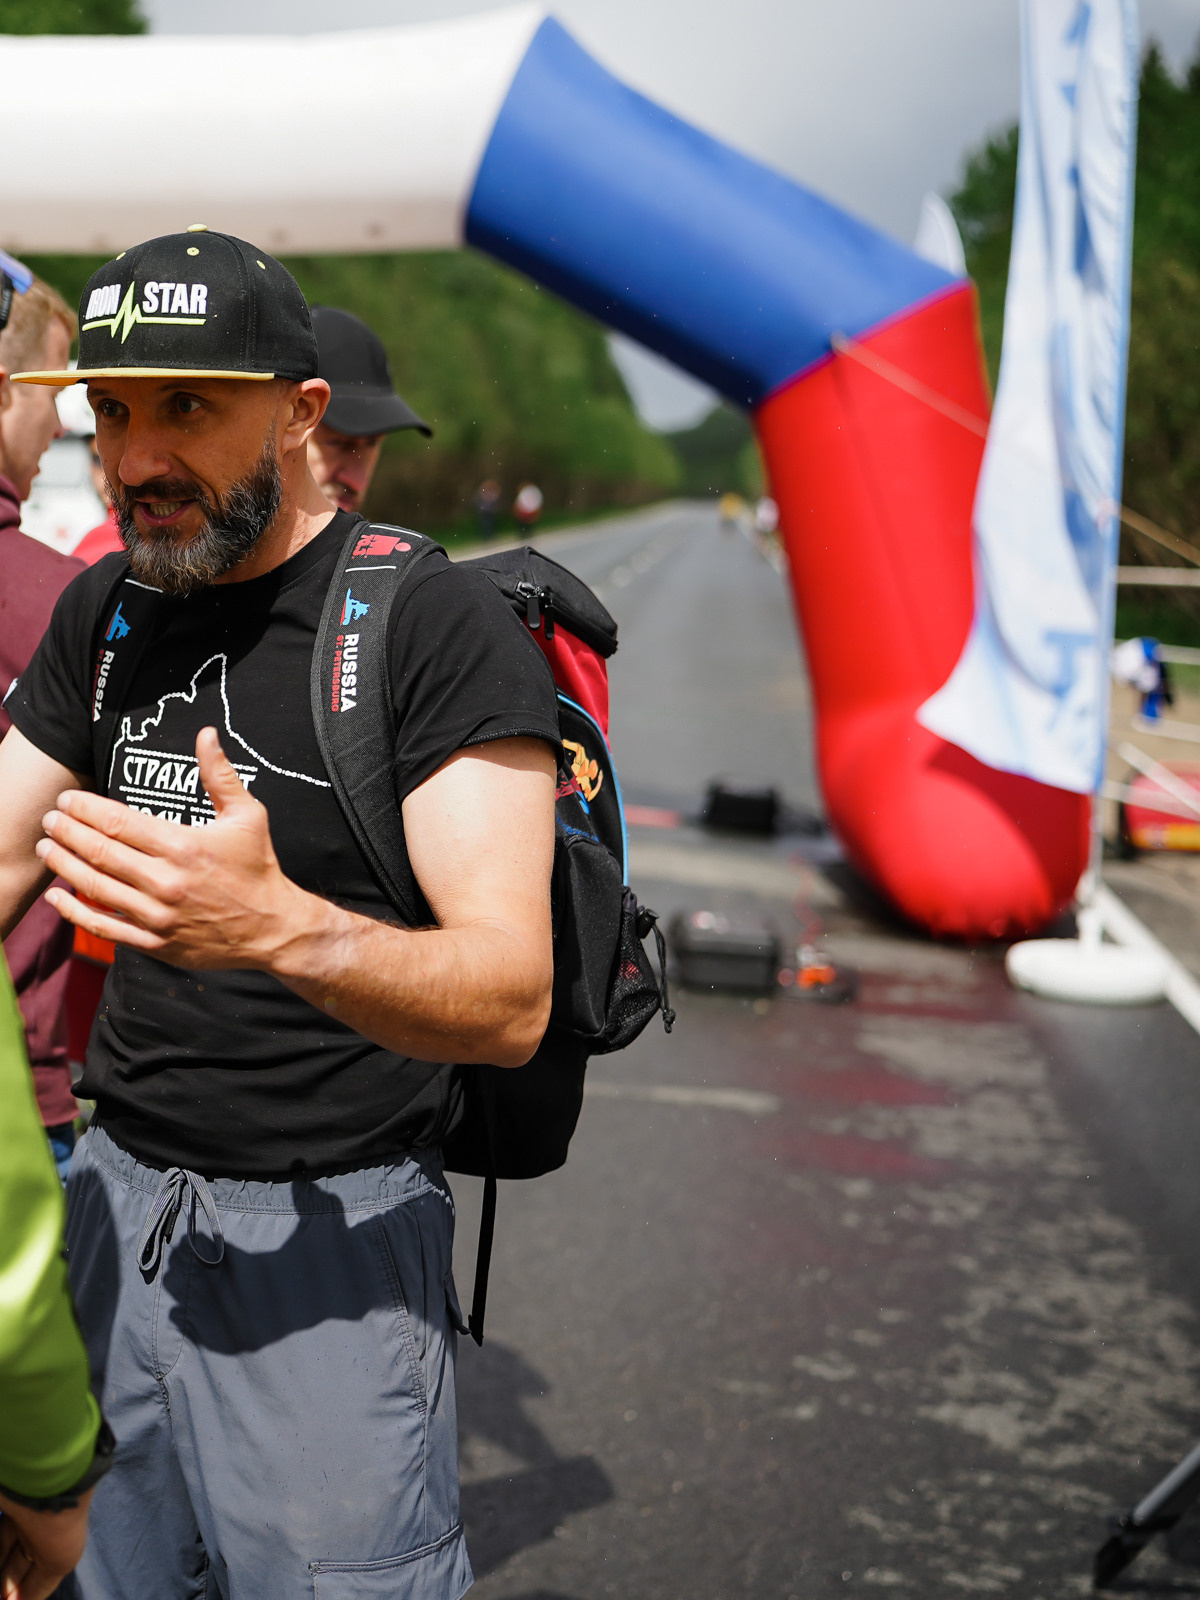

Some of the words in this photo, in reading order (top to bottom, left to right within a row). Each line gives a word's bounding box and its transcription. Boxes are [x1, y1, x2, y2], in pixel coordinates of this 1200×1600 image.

[142, 281, 208, 314] STAR
[336, 635, 345, 649] ST.
[93, 650, 115, 722] RUSSIA
[331, 650, 342, 712] PETERSBURG
[340, 633, 360, 713] RUSSIA
[123, 755, 201, 795] СТРАХА
